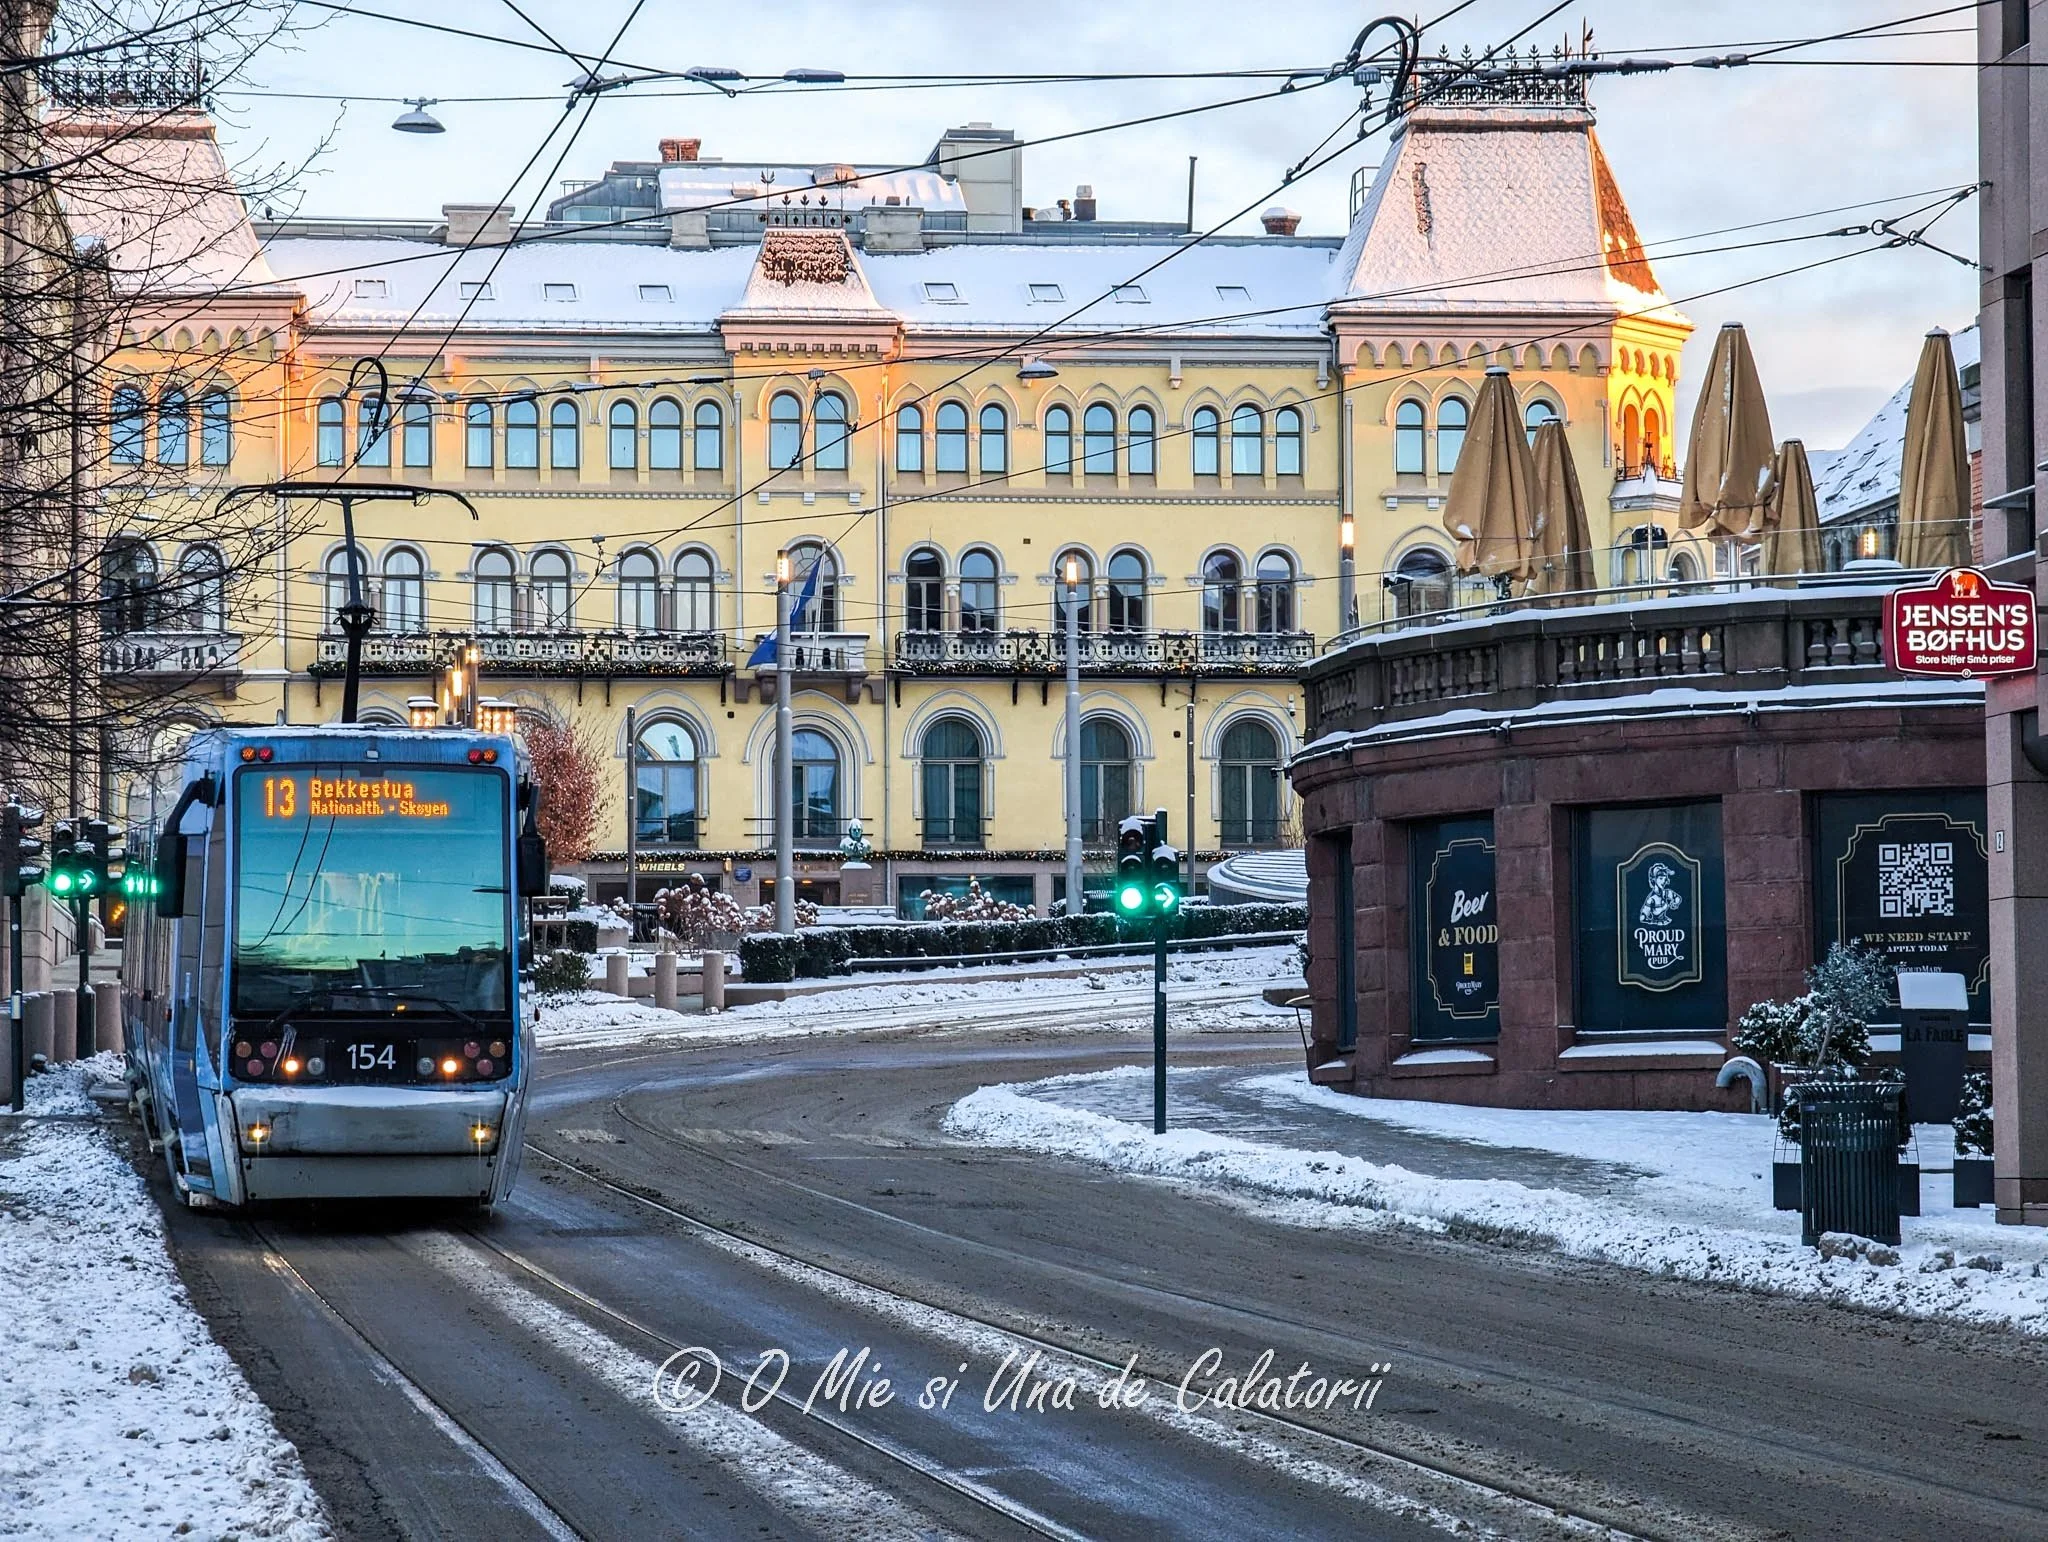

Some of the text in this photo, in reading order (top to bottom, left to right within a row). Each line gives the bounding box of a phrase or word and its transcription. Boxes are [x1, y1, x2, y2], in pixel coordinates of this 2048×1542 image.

[1901, 604, 2028, 627] JENSEN'S
[1906, 629, 2025, 651] BØFHUS
[1915, 654, 2016, 666] Store biffer Små priser
[265, 779, 295, 816] 13
[311, 779, 414, 799] Bekkestua
[311, 800, 385, 815] Nationalth.
[399, 800, 448, 817] Skøyen
[1450, 889, 1489, 923] Beer
[1438, 924, 1499, 947] & FOOD
[1634, 927, 1685, 949] PROUD
[1864, 931, 1972, 943] WE NEED STAFF
[1644, 943, 1680, 957] MARY
[1886, 944, 1949, 953] APPLY TODAY
[346, 1044, 397, 1070] 154
